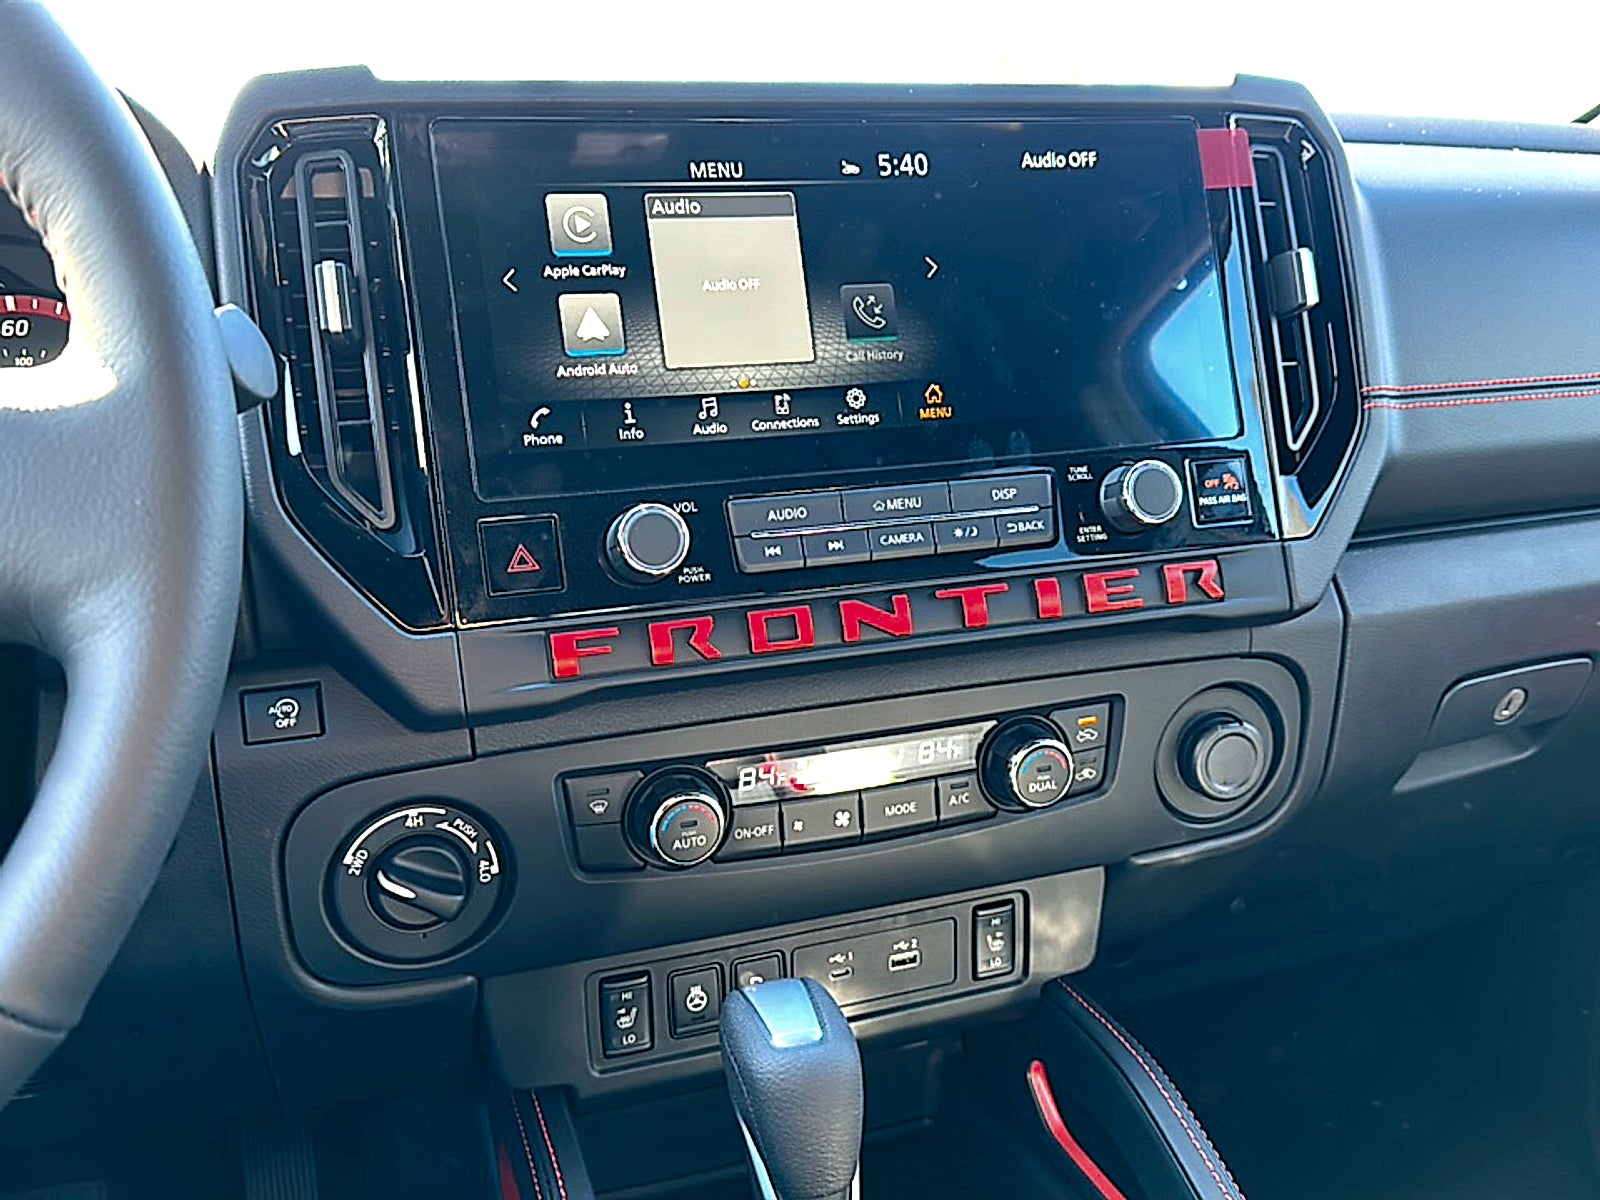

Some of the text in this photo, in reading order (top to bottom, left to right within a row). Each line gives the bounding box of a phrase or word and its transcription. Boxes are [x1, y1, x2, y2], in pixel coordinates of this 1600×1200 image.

[877, 152, 928, 176] 5:40
[1022, 151, 1097, 168] Audio OFF
[690, 162, 743, 178] MENU
[651, 199, 701, 215] Audio
[543, 264, 626, 279] Apple CarPlay
[702, 278, 761, 292] Audio OFF
[1, 319, 29, 337] 60
[14, 356, 34, 366] 100
[845, 349, 904, 361] Call History
[556, 363, 638, 378] Android Auto
[836, 412, 880, 426] Settings
[919, 407, 953, 420] MENU
[692, 422, 728, 436] Audio
[751, 416, 820, 431] Connections
[523, 433, 563, 447] Phone
[618, 427, 645, 440] Info
[991, 488, 1018, 501] DISP
[1199, 496, 1218, 506] PASS
[673, 502, 698, 514] VOL
[886, 496, 922, 511] MENU
[767, 507, 808, 522] AUDIO
[1017, 520, 1045, 532] BACK
[879, 531, 925, 546] CAMERA
[678, 573, 711, 584] POWER
[549, 559, 1225, 679] FRONTIER
[274, 717, 297, 729] OFF
[1029, 782, 1057, 793] DUAL
[949, 793, 970, 806] A/C
[884, 802, 917, 817] MODE
[405, 815, 424, 828] 4H
[453, 818, 478, 839] PUSH
[734, 824, 775, 840] ON-OFF
[671, 835, 707, 850] AUTO
[348, 849, 369, 877] 2WD
[479, 860, 491, 883] 4LO
[621, 992, 634, 1002] HI
[622, 1033, 637, 1046] LO
